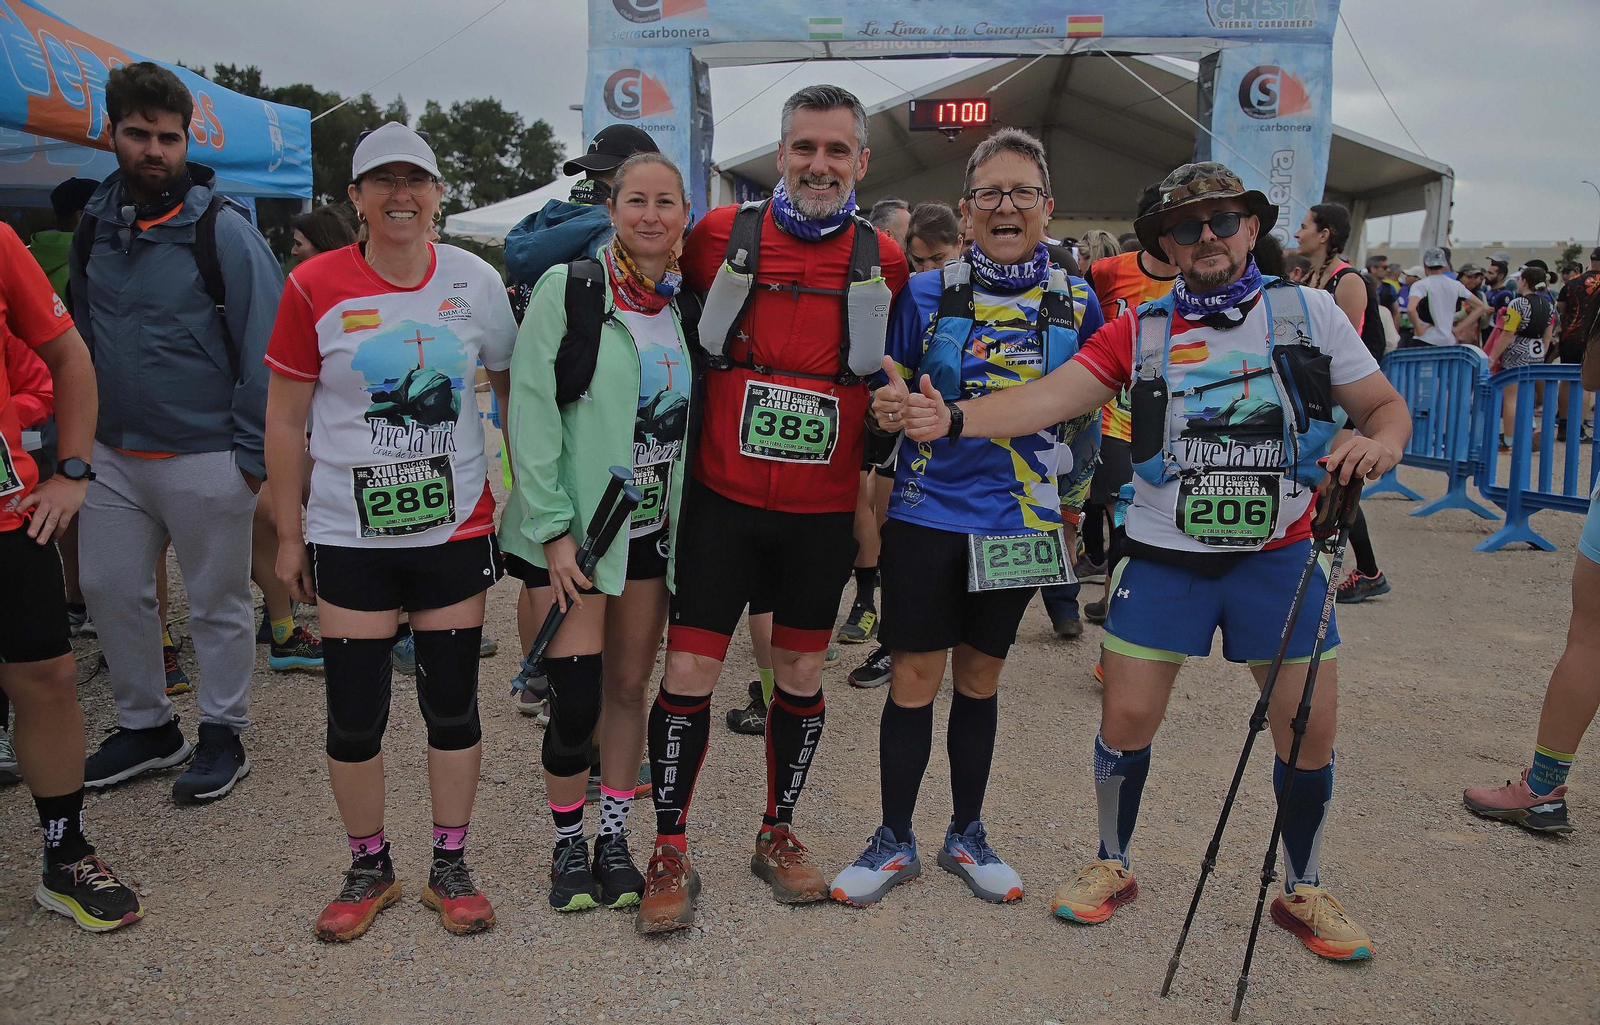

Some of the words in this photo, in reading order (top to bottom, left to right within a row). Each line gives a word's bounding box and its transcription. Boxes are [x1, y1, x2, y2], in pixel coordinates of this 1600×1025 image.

[857, 20, 880, 37] La
[932, 24, 950, 36] de
[954, 24, 968, 36] la
[973, 21, 1055, 38] Concepción
[1218, 20, 1253, 29] SIERRA
[1258, 19, 1314, 29] CARBONERA
[766, 388, 791, 403] XIII
[791, 397, 820, 408] CRESTA
[759, 398, 825, 417] CARBONERA
[368, 417, 406, 449] Vive
[407, 419, 426, 454] la
[754, 411, 825, 443] 383
[1226, 438, 1246, 467] la
[367, 469, 440, 488] CARBONERA
[371, 464, 398, 479] XIII
[398, 465, 432, 476] CRESTA
[1198, 475, 1225, 487] XIII
[368, 482, 445, 517] 286
[1191, 486, 1267, 496] CARBONERA
[1190, 499, 1268, 526] 206
[988, 540, 1053, 569] 230
[657, 714, 692, 804] kalenji
[782, 716, 823, 803] kalenji
